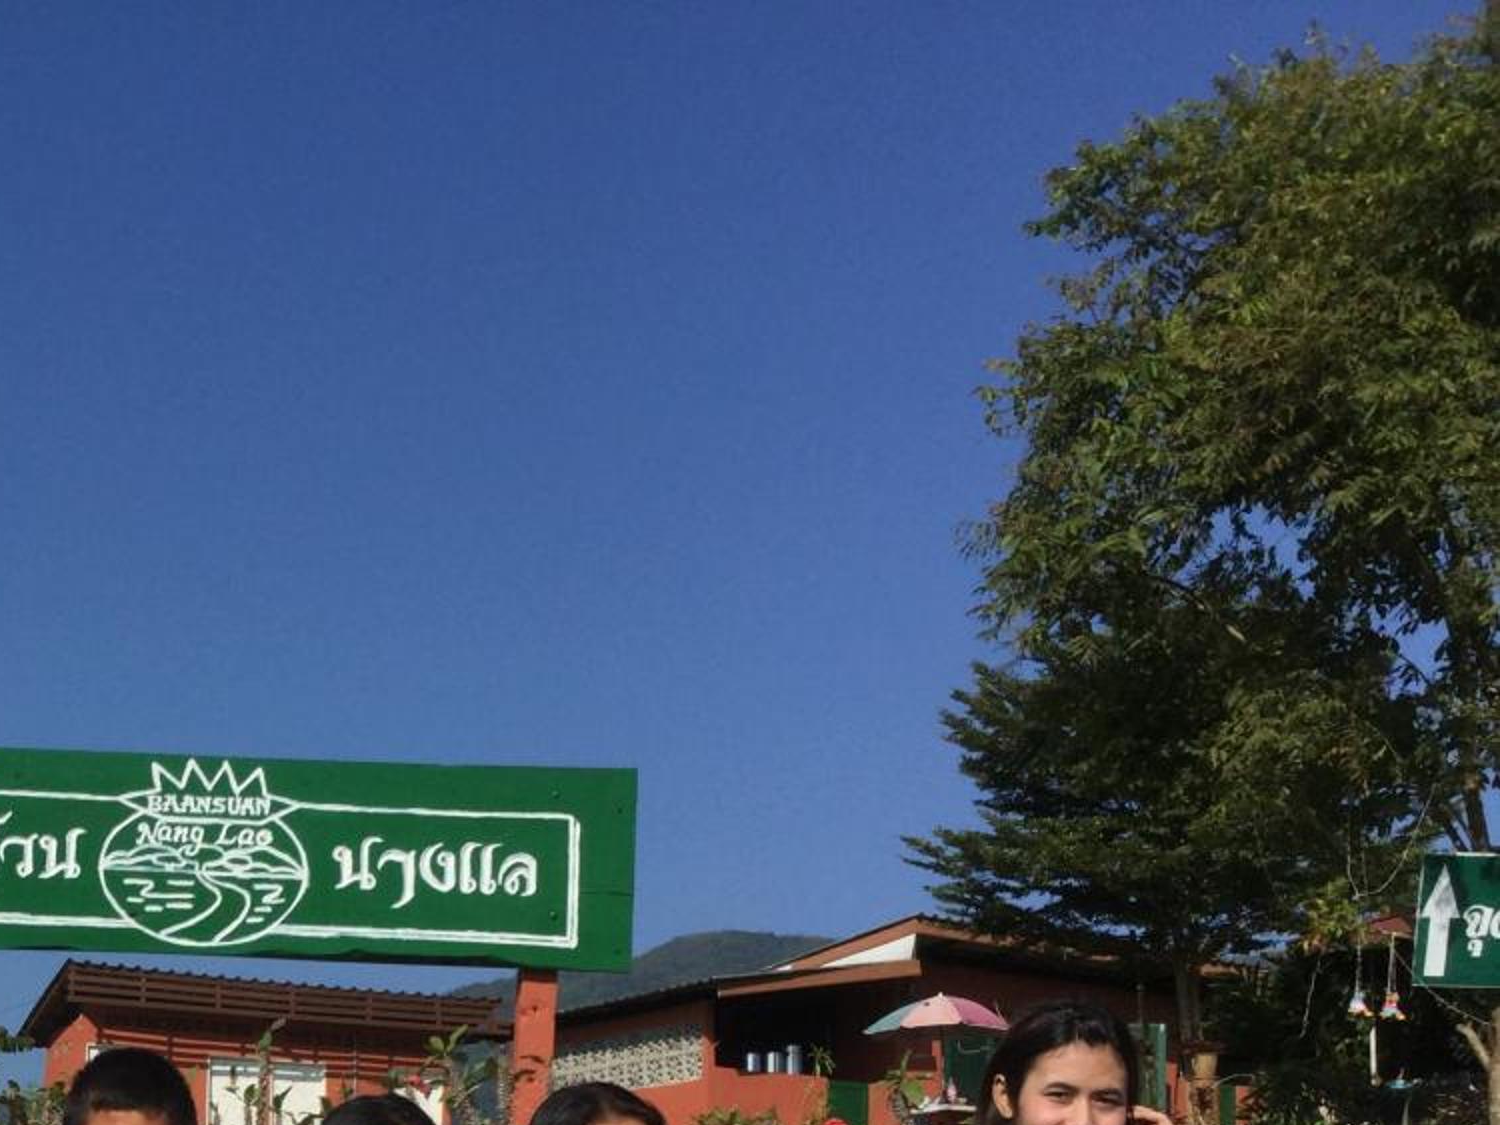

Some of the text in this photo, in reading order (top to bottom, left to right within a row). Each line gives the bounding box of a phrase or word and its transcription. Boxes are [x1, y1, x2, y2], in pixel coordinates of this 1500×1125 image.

[147, 794, 270, 816] BAANSUAN
[136, 821, 205, 857] Nang
[332, 836, 538, 909] นางแล
[1463, 903, 1500, 957] จุ
